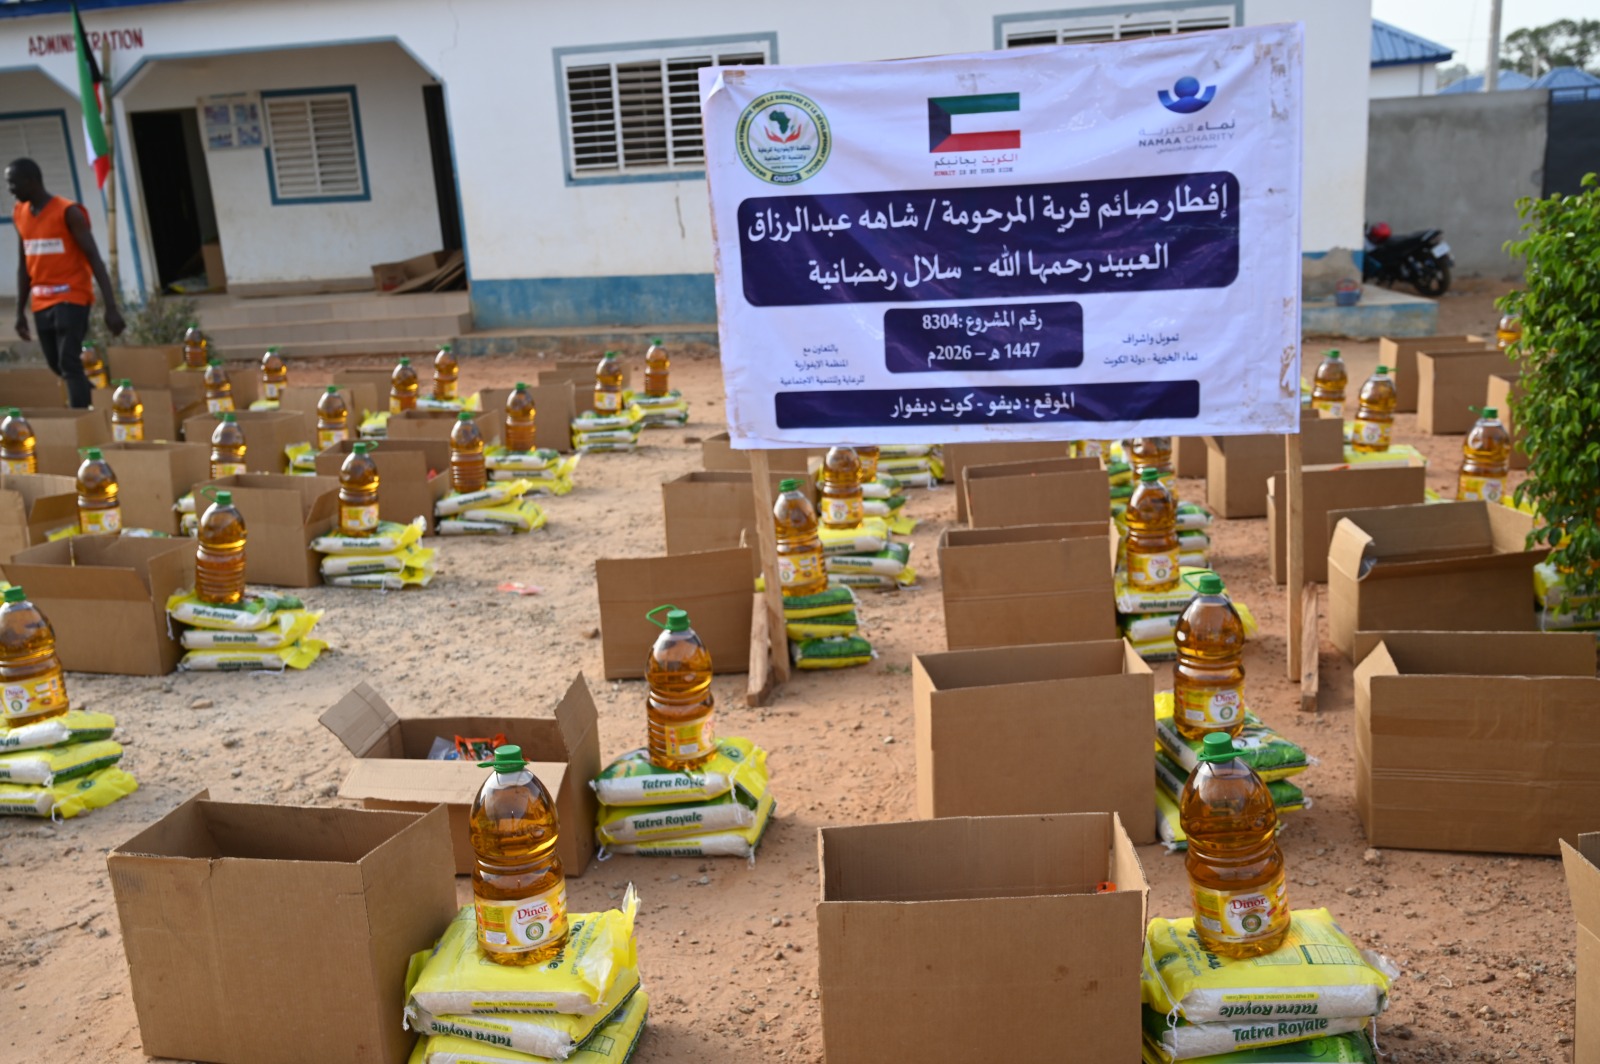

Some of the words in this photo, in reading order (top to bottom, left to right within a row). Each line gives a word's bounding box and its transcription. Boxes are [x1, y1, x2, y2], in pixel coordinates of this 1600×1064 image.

[1138, 137, 1181, 147] NAMAA
[1184, 132, 1235, 144] CHARITY
[934, 156, 977, 169] بجانبكم
[982, 153, 1018, 166] الكويت
[1042, 193, 1091, 233] قرية
[1097, 189, 1159, 230] صائم
[1159, 182, 1228, 222] إفطار
[858, 201, 919, 230] شاهه
[942, 195, 1035, 234] المرحومة
[903, 254, 962, 288] سلال
[987, 244, 1021, 277] الله
[1027, 249, 1093, 284] رحمها
[1099, 242, 1169, 277] العبيد
[808, 258, 898, 291] رمضانية
[1018, 309, 1043, 332] رقم
[1003, 342, 1041, 359] 1447
[889, 396, 937, 419] ديفوار
[940, 393, 975, 418] كوت
[985, 395, 1022, 416] ديفو
[1033, 391, 1075, 418] الموقع
[642, 778, 673, 790] Tatra
[632, 818, 664, 830] Tatra
[665, 811, 703, 826] Royale
[517, 904, 548, 920] Dinor
[1230, 897, 1266, 910] Dinor
[1219, 1001, 1273, 1018] Royale
[1276, 1003, 1318, 1015] Tatra
[431, 1021, 473, 1041] Royale
[475, 1031, 513, 1048] Tatra
[1232, 1026, 1274, 1042] Tatra
[1277, 1018, 1328, 1037] Royale
